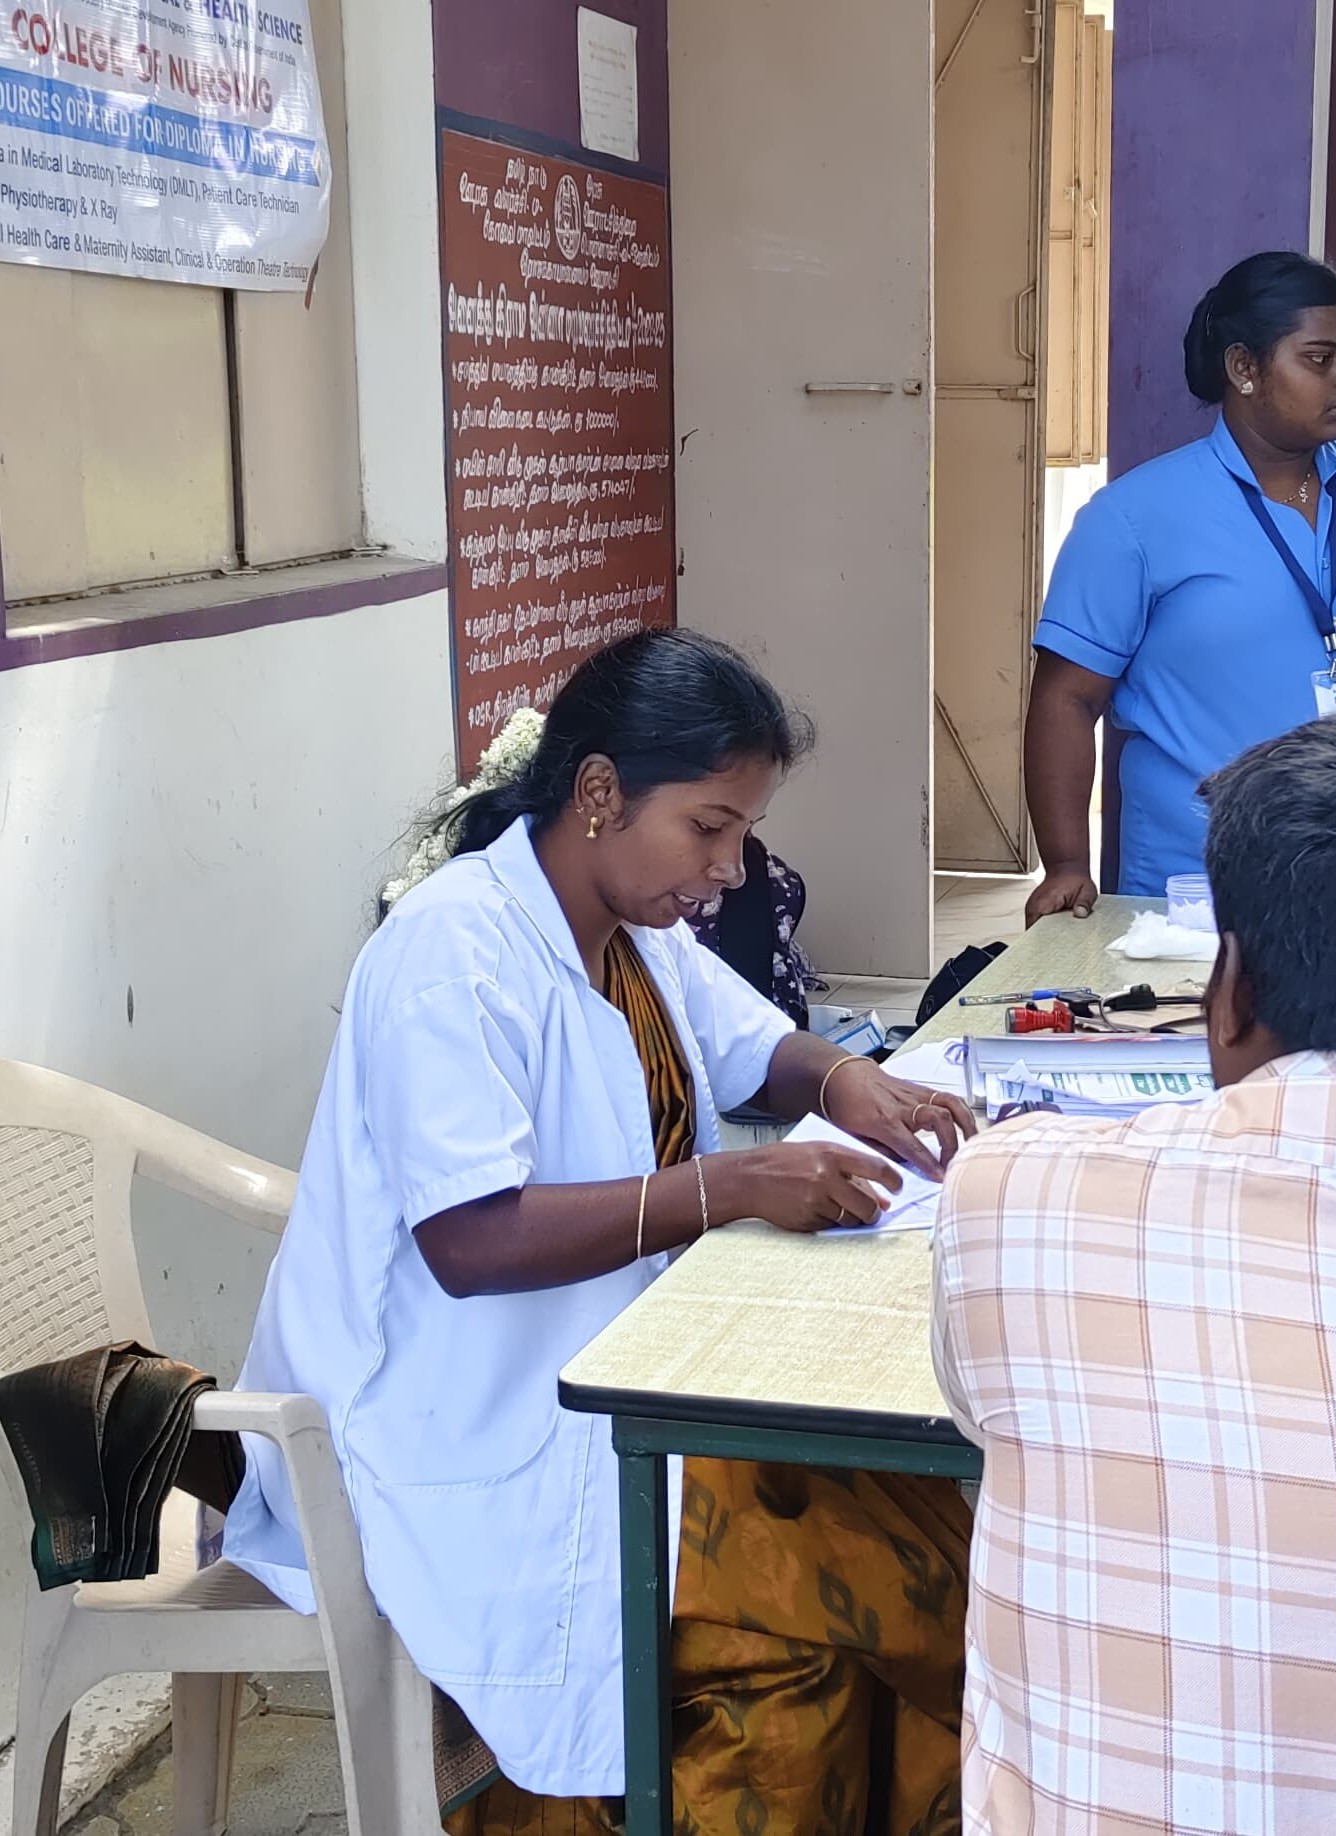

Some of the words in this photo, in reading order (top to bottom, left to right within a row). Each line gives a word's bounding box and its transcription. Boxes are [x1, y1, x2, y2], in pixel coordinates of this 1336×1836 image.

[12, 8, 124, 77] COLLEGE
[136, 43, 162, 85] OF
[168, 54, 273, 114] NURSING
[257, 10, 303, 45] SCIENCE
[66, 95, 130, 137] OFFERED
[134, 110, 164, 145] FOR
[165, 121, 224, 159] DIPLOMA
[228, 134, 245, 162] IN
[0, 183, 78, 218] Physiotherapy
[80, 196, 88, 215] &
[90, 199, 98, 217] X
[101, 200, 118, 224] Ray
[8, 144, 18, 160] in
[21, 146, 62, 172] Medical
[66, 155, 114, 187] Laboratory
[116, 165, 168, 196] Technology
[202, 183, 233, 205] Patient
[236, 188, 257, 207] Care
[259, 191, 299, 214] Technician
[7, 224, 41, 247] Health
[44, 229, 70, 251] Care
[74, 233, 82, 253] &
[84, 234, 128, 262] Maternity
[131, 241, 174, 268] Assistant,
[175, 247, 204, 269] Clinical
[206, 251, 213, 270] &
[215, 253, 255, 275] Operation
[258, 258, 282, 278] Theatre
[448, 280, 494, 348] அனைத்து
[496, 282, 527, 350] கிராம
